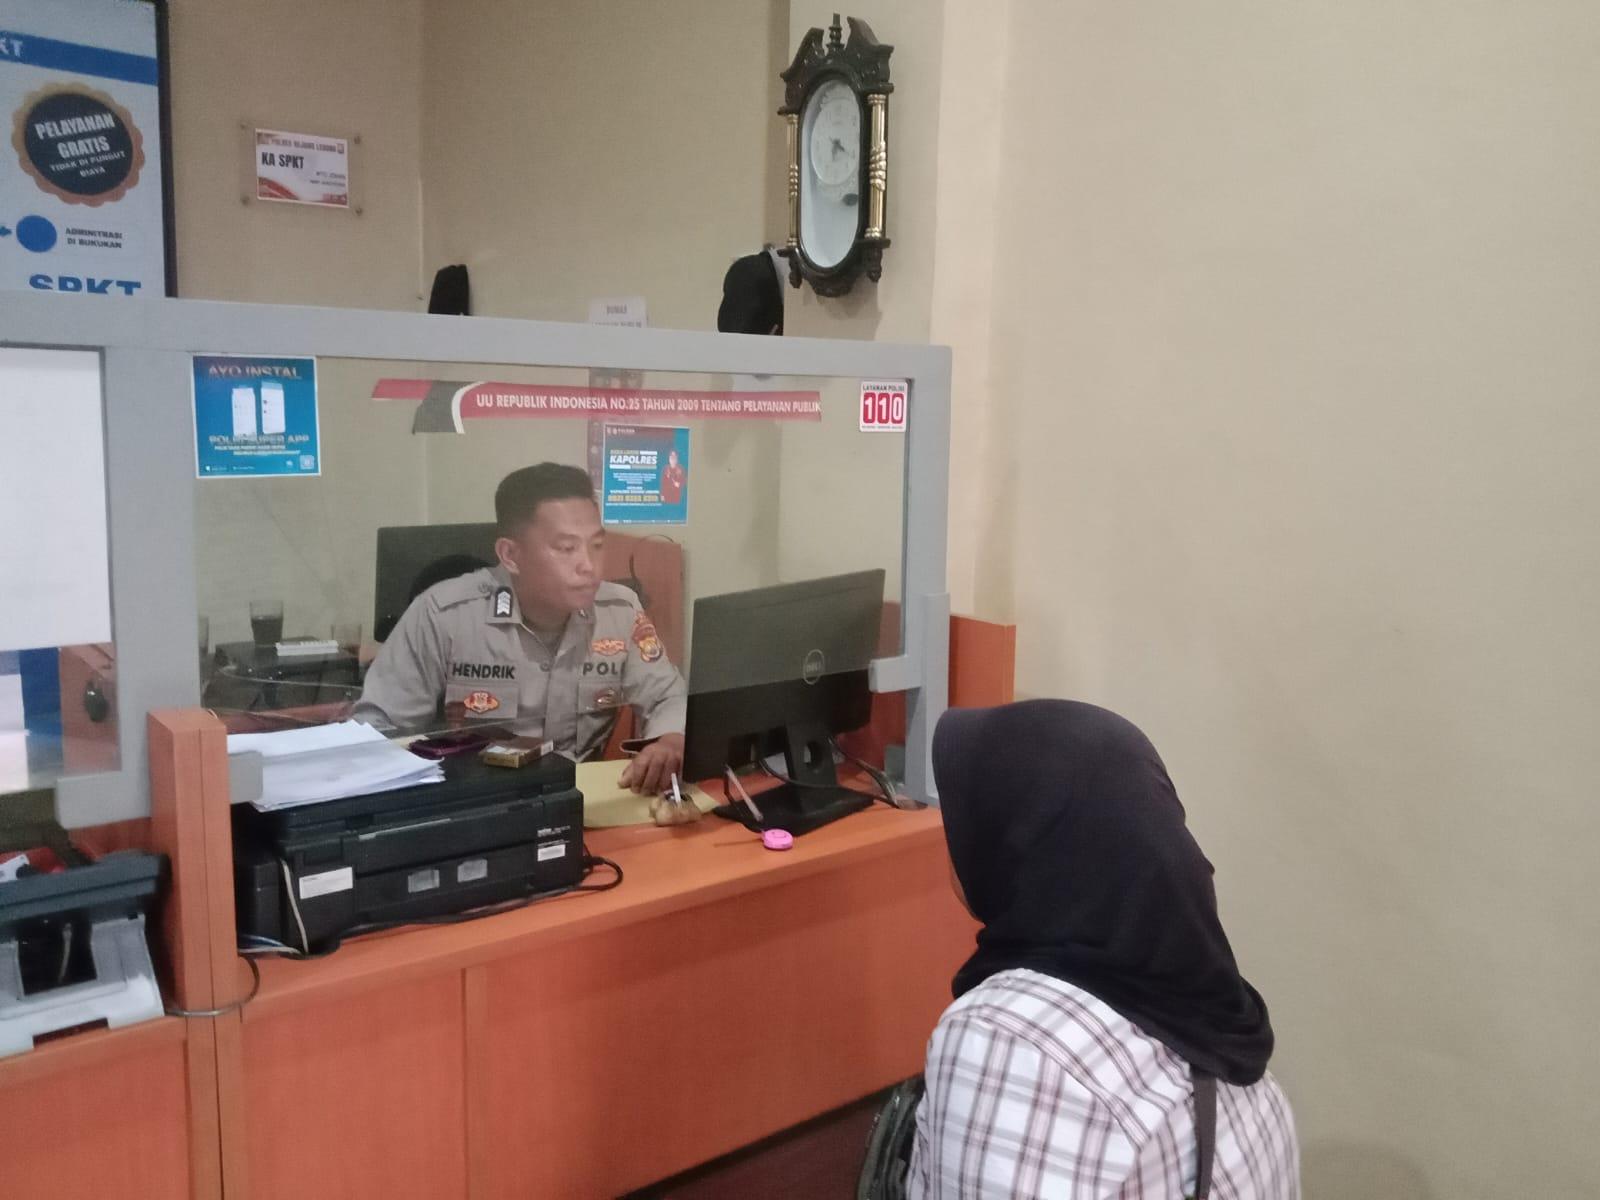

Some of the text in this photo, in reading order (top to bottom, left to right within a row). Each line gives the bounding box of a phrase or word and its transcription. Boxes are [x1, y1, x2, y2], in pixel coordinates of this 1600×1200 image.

[35, 112, 115, 140] PELAYANAN
[57, 135, 110, 158] GRATIS
[262, 151, 304, 169] KA SPKT
[67, 237, 76, 245] DI
[476, 394, 821, 413] UU REPUBLIK INDONESIA NO.25 TAHUN 2009 TENTANG PELAYANAN PUBLIK
[863, 392, 905, 424] 110
[609, 455, 657, 465] KAPOLRES
[452, 662, 516, 679] HENDRIK
